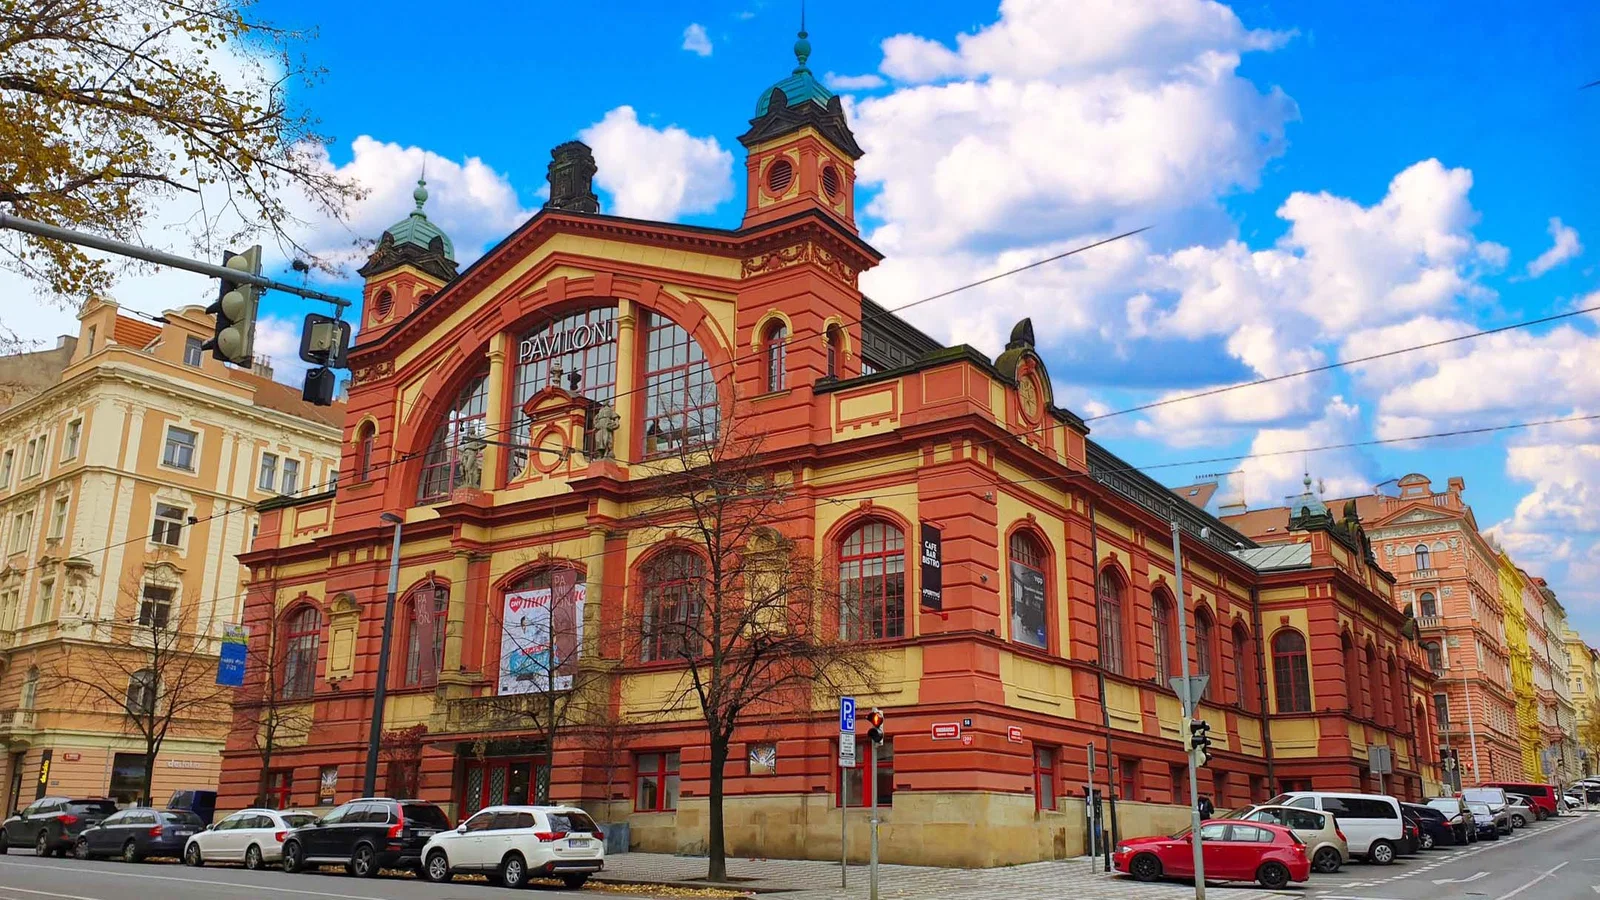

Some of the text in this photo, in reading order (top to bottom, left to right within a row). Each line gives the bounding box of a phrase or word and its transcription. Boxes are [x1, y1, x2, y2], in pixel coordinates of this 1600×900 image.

[925, 540, 937, 552] CAFE
[925, 549, 937, 560] BAR
[922, 555, 940, 569] BISTRO
